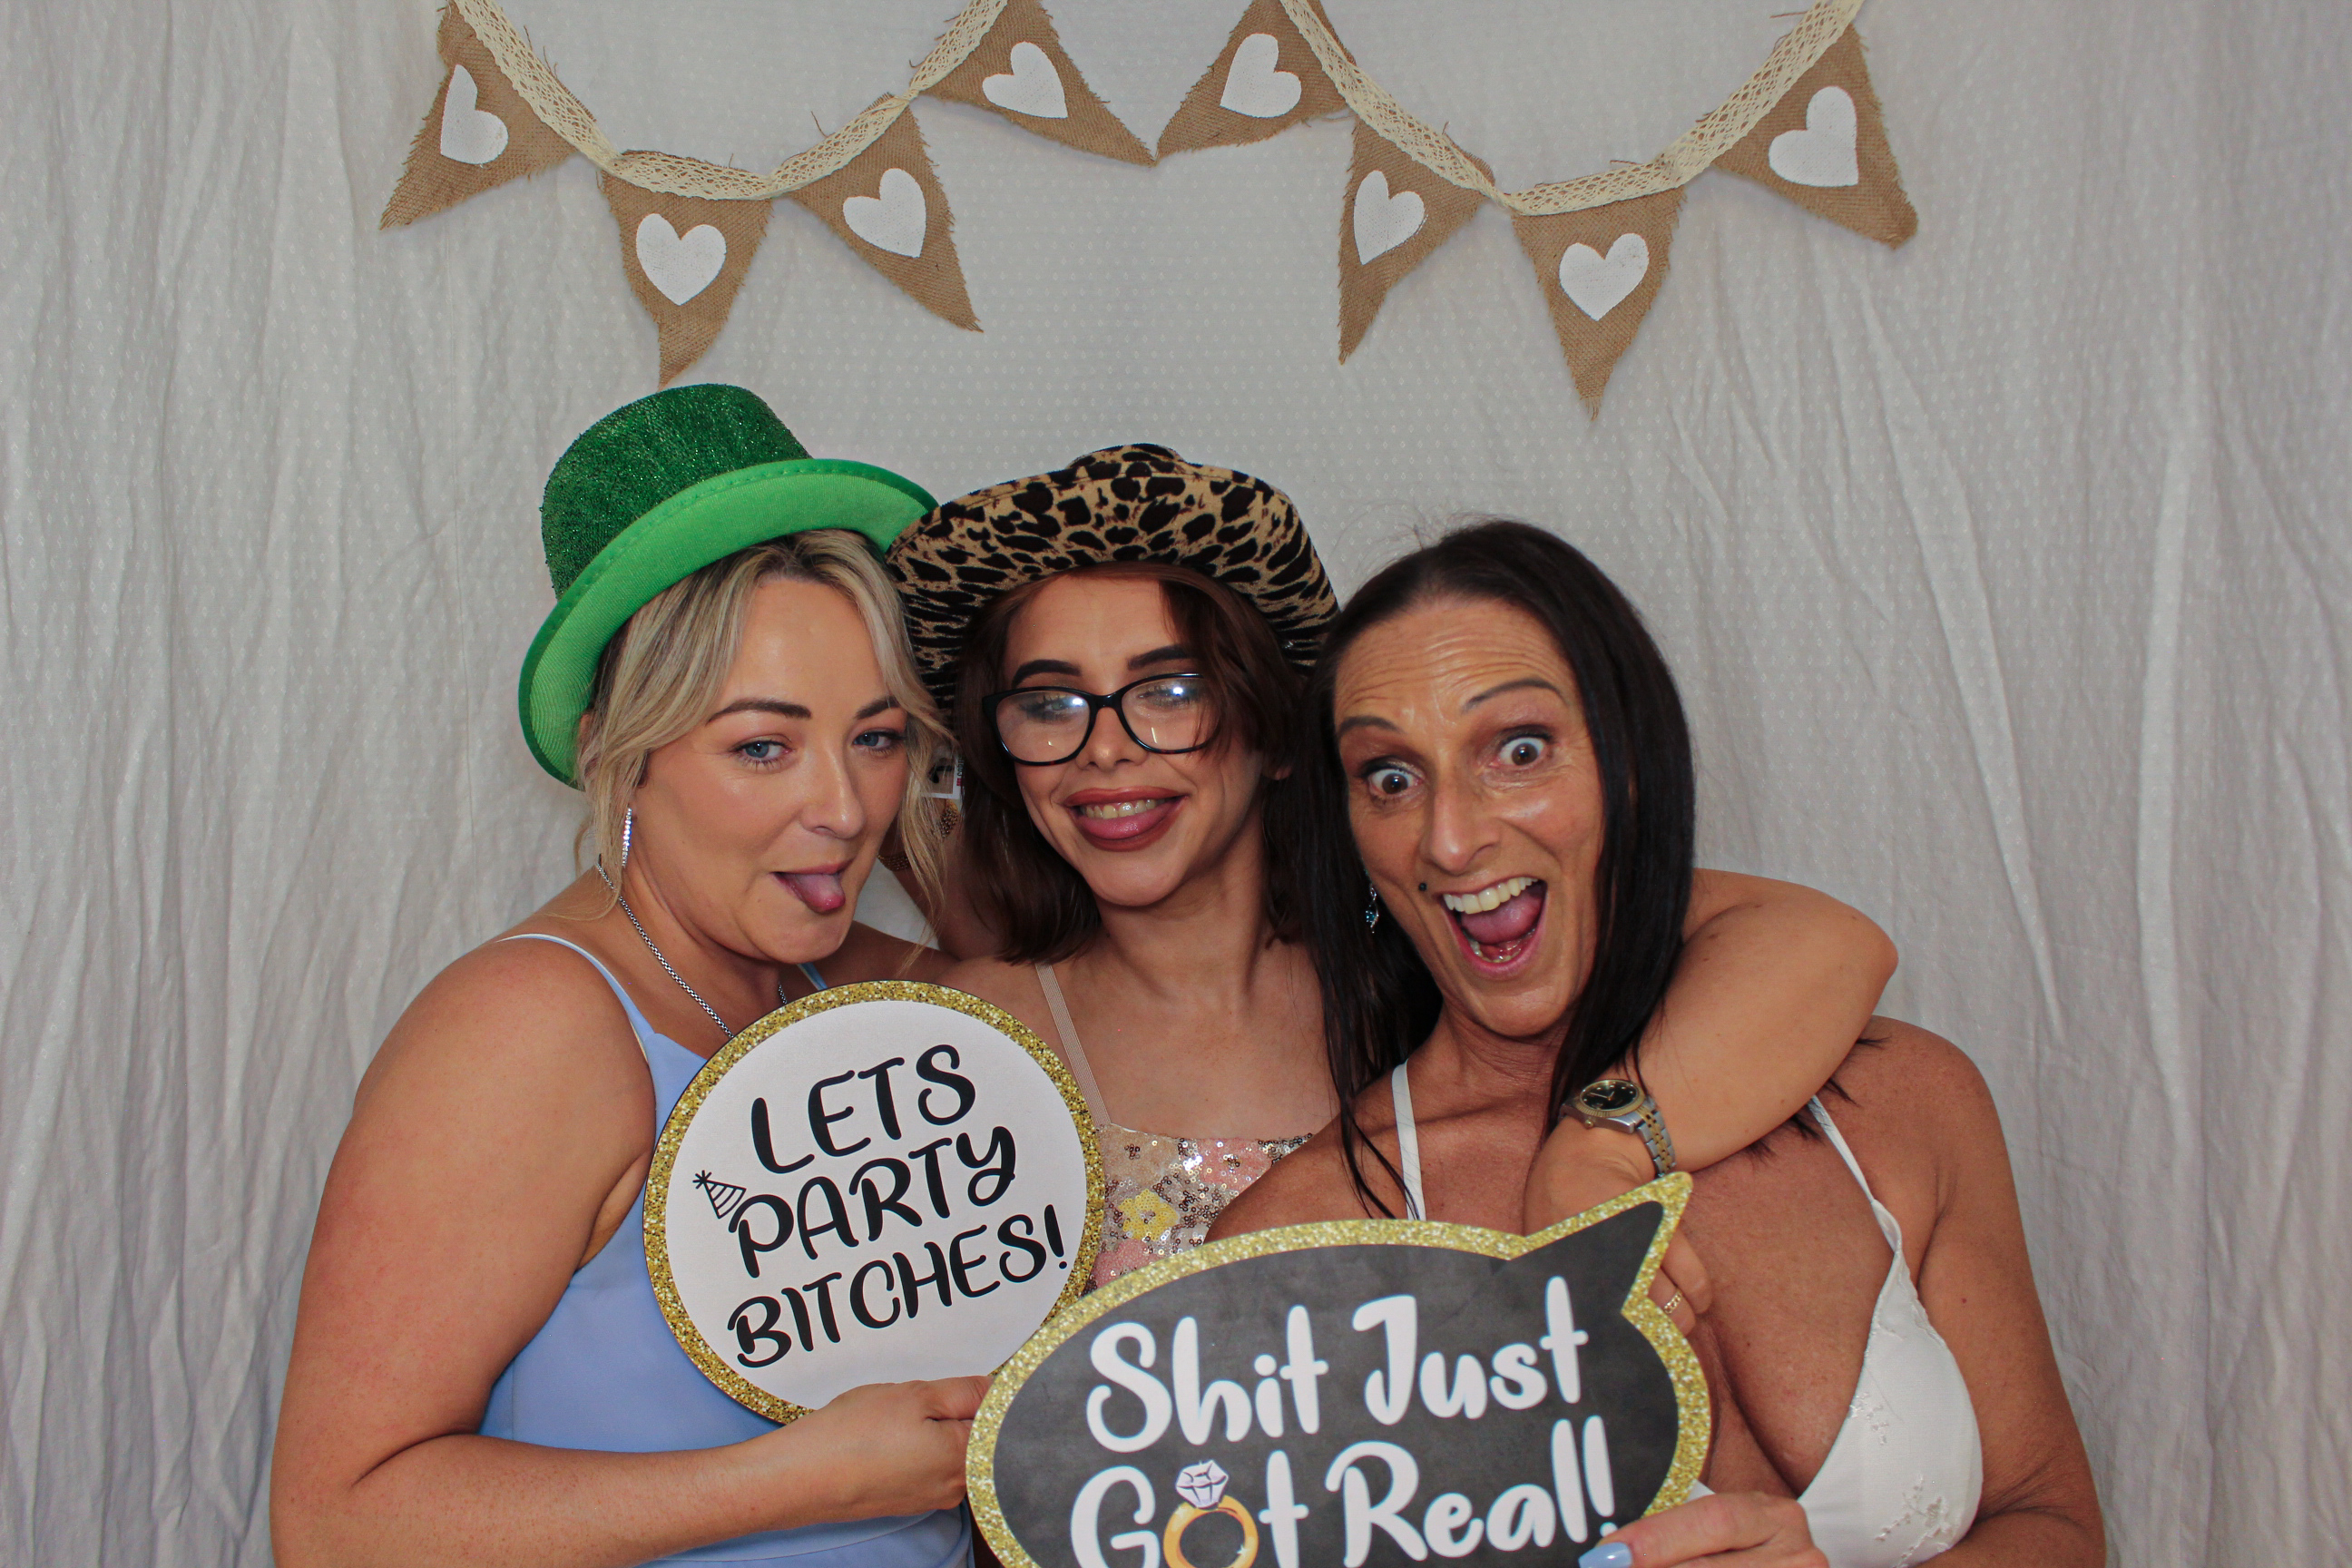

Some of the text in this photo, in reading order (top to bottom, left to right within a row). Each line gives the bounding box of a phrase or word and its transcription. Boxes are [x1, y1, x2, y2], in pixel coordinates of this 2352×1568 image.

[750, 1044, 976, 1174] LETS
[728, 1125, 1017, 1279] PARTY
[727, 1203, 1068, 1368] BITCHES!
[1085, 1275, 1589, 1454] Shit Just
[1324, 1415, 1619, 1568] Real!
